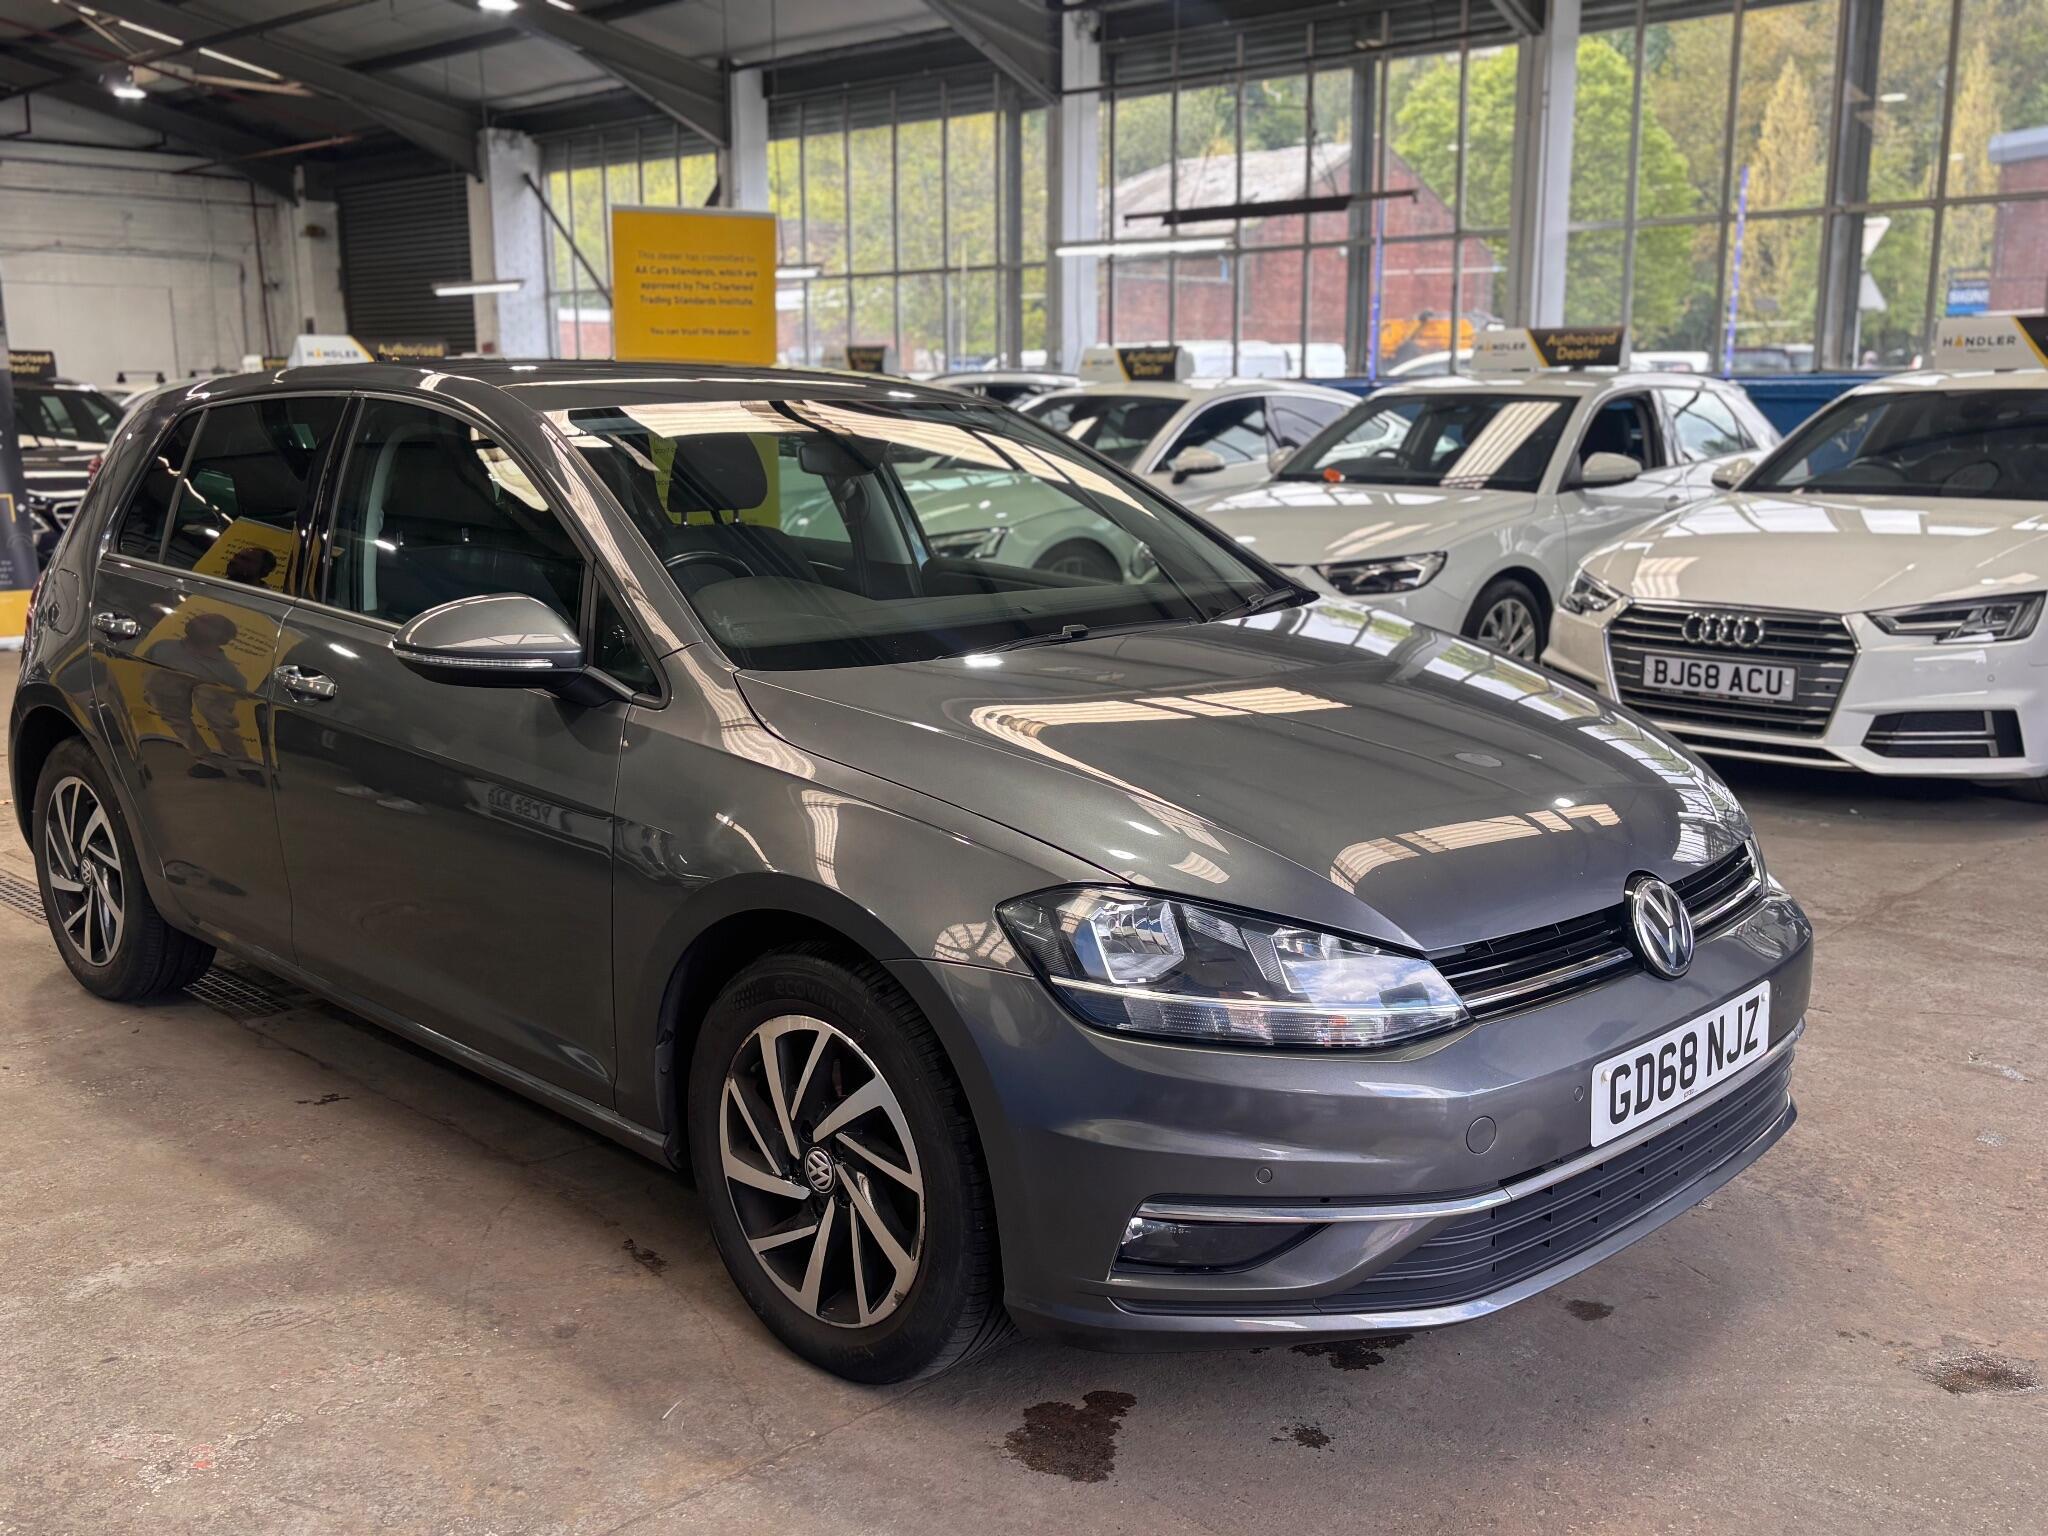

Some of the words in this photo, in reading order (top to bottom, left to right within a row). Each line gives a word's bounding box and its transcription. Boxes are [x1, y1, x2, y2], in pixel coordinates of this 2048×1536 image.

[1545, 330, 1618, 347] Authorised
[1556, 345, 1602, 360] Dealer
[1653, 659, 1721, 690] BJ68
[1728, 665, 1784, 696] ACU
[1609, 1030, 1698, 1125] GD68
[1706, 995, 1761, 1078] NJZ
